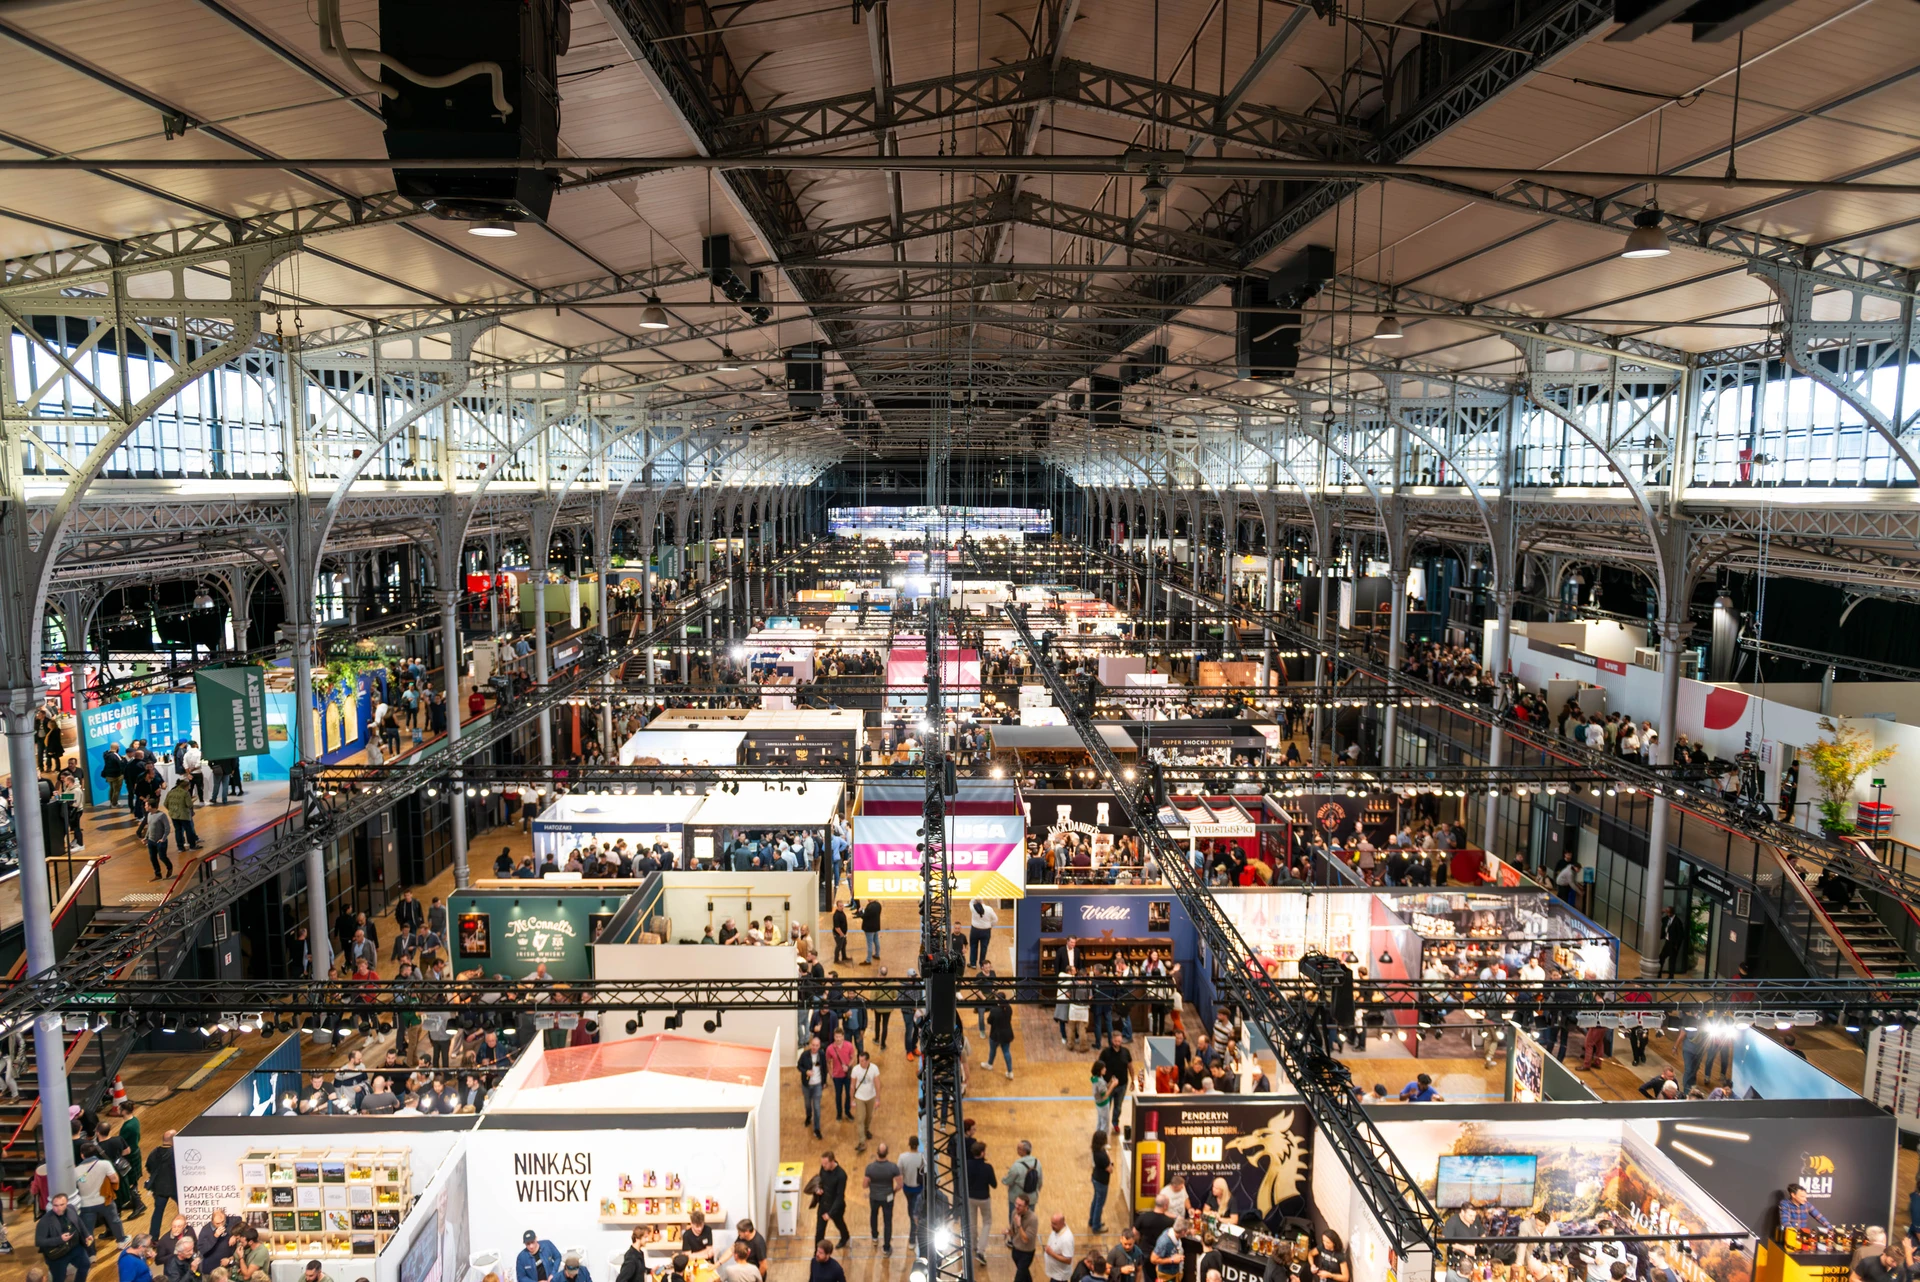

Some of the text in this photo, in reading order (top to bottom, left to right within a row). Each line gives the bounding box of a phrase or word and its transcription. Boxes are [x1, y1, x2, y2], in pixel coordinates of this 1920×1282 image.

[1604, 662, 1618, 671] LIVE
[88, 704, 138, 726] RENEGADE
[247, 673, 264, 750] GALLERY
[90, 716, 140, 739] CANE RUM
[232, 699, 247, 751] RHUM
[955, 824, 1006, 838] USA
[1047, 820, 1100, 835] JACK DANIEL'S
[1182, 1111, 1228, 1120] PENDERYN
[1164, 1126, 1176, 1135] THE
[1177, 1126, 1202, 1135] DRAGON
[1204, 1126, 1210, 1134] IS
[514, 1153, 591, 1175] NINKASI
[516, 1180, 591, 1202] WHISKY
[1799, 1177, 1832, 1193] M&H
[1823, 1266, 1849, 1274] BOLD
